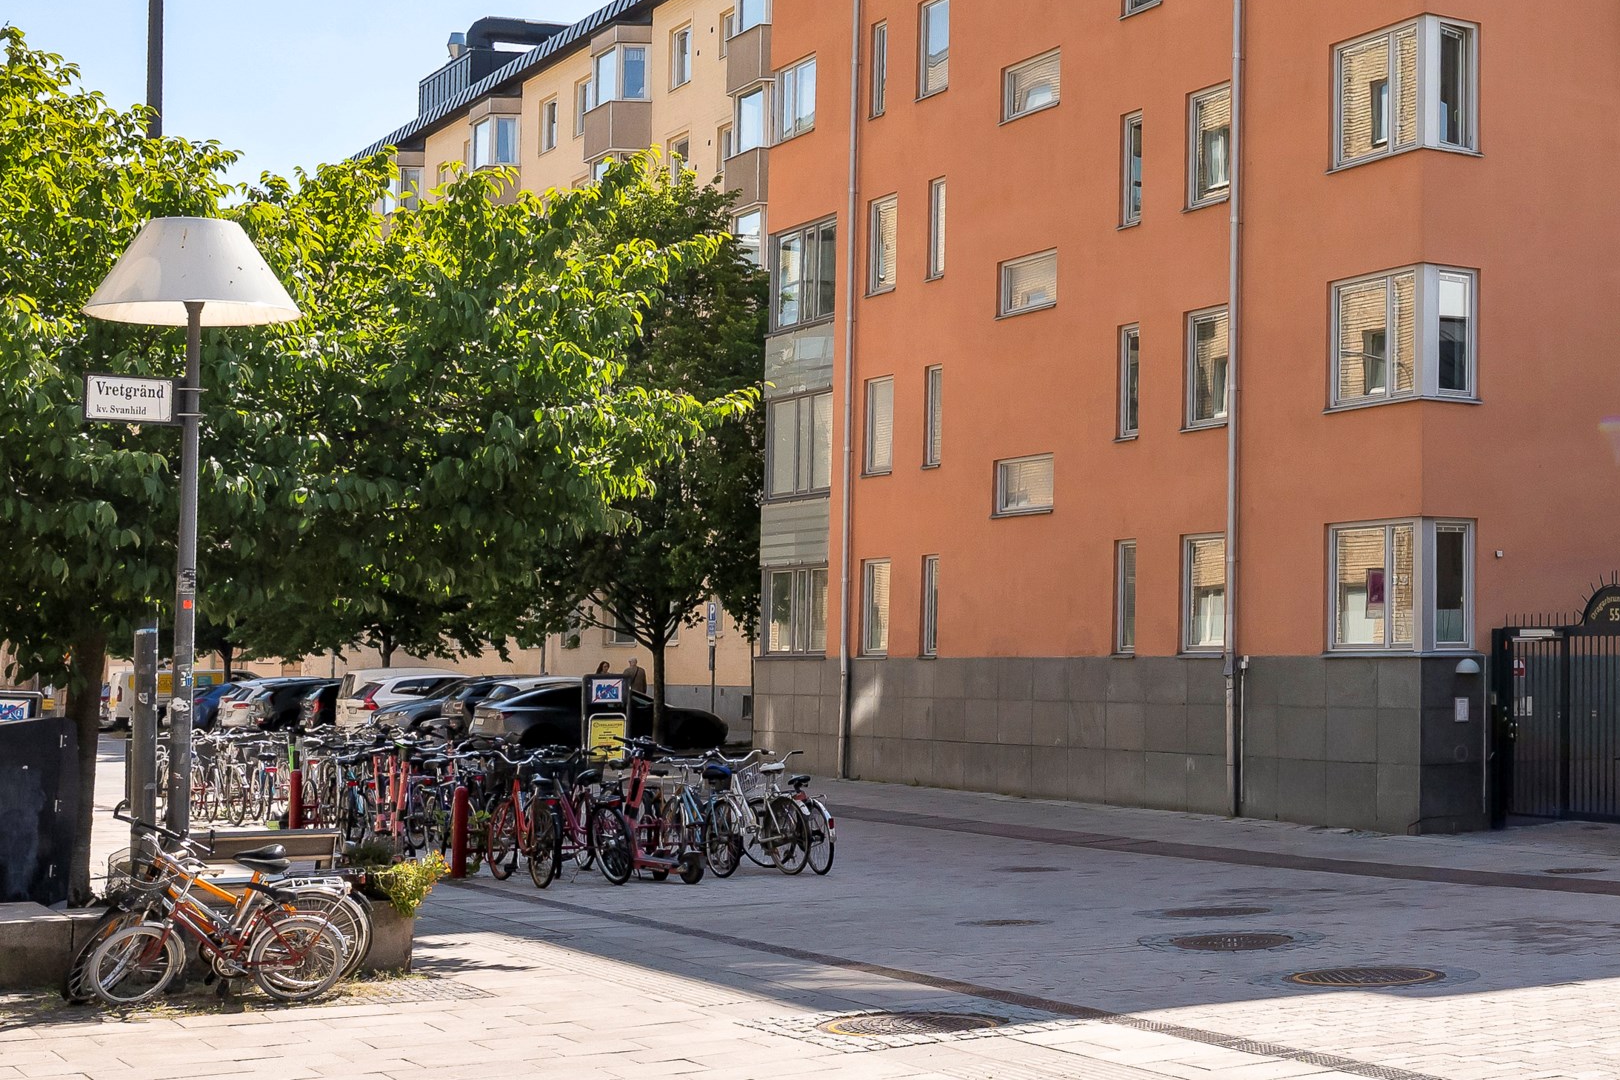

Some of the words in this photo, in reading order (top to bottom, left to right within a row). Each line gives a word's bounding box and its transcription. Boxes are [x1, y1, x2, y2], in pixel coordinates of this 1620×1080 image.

[96, 381, 165, 400] Vretgränd
[96, 404, 108, 413] kv.
[109, 405, 147, 415] Svanhild
[1610, 608, 1620, 621] 55
